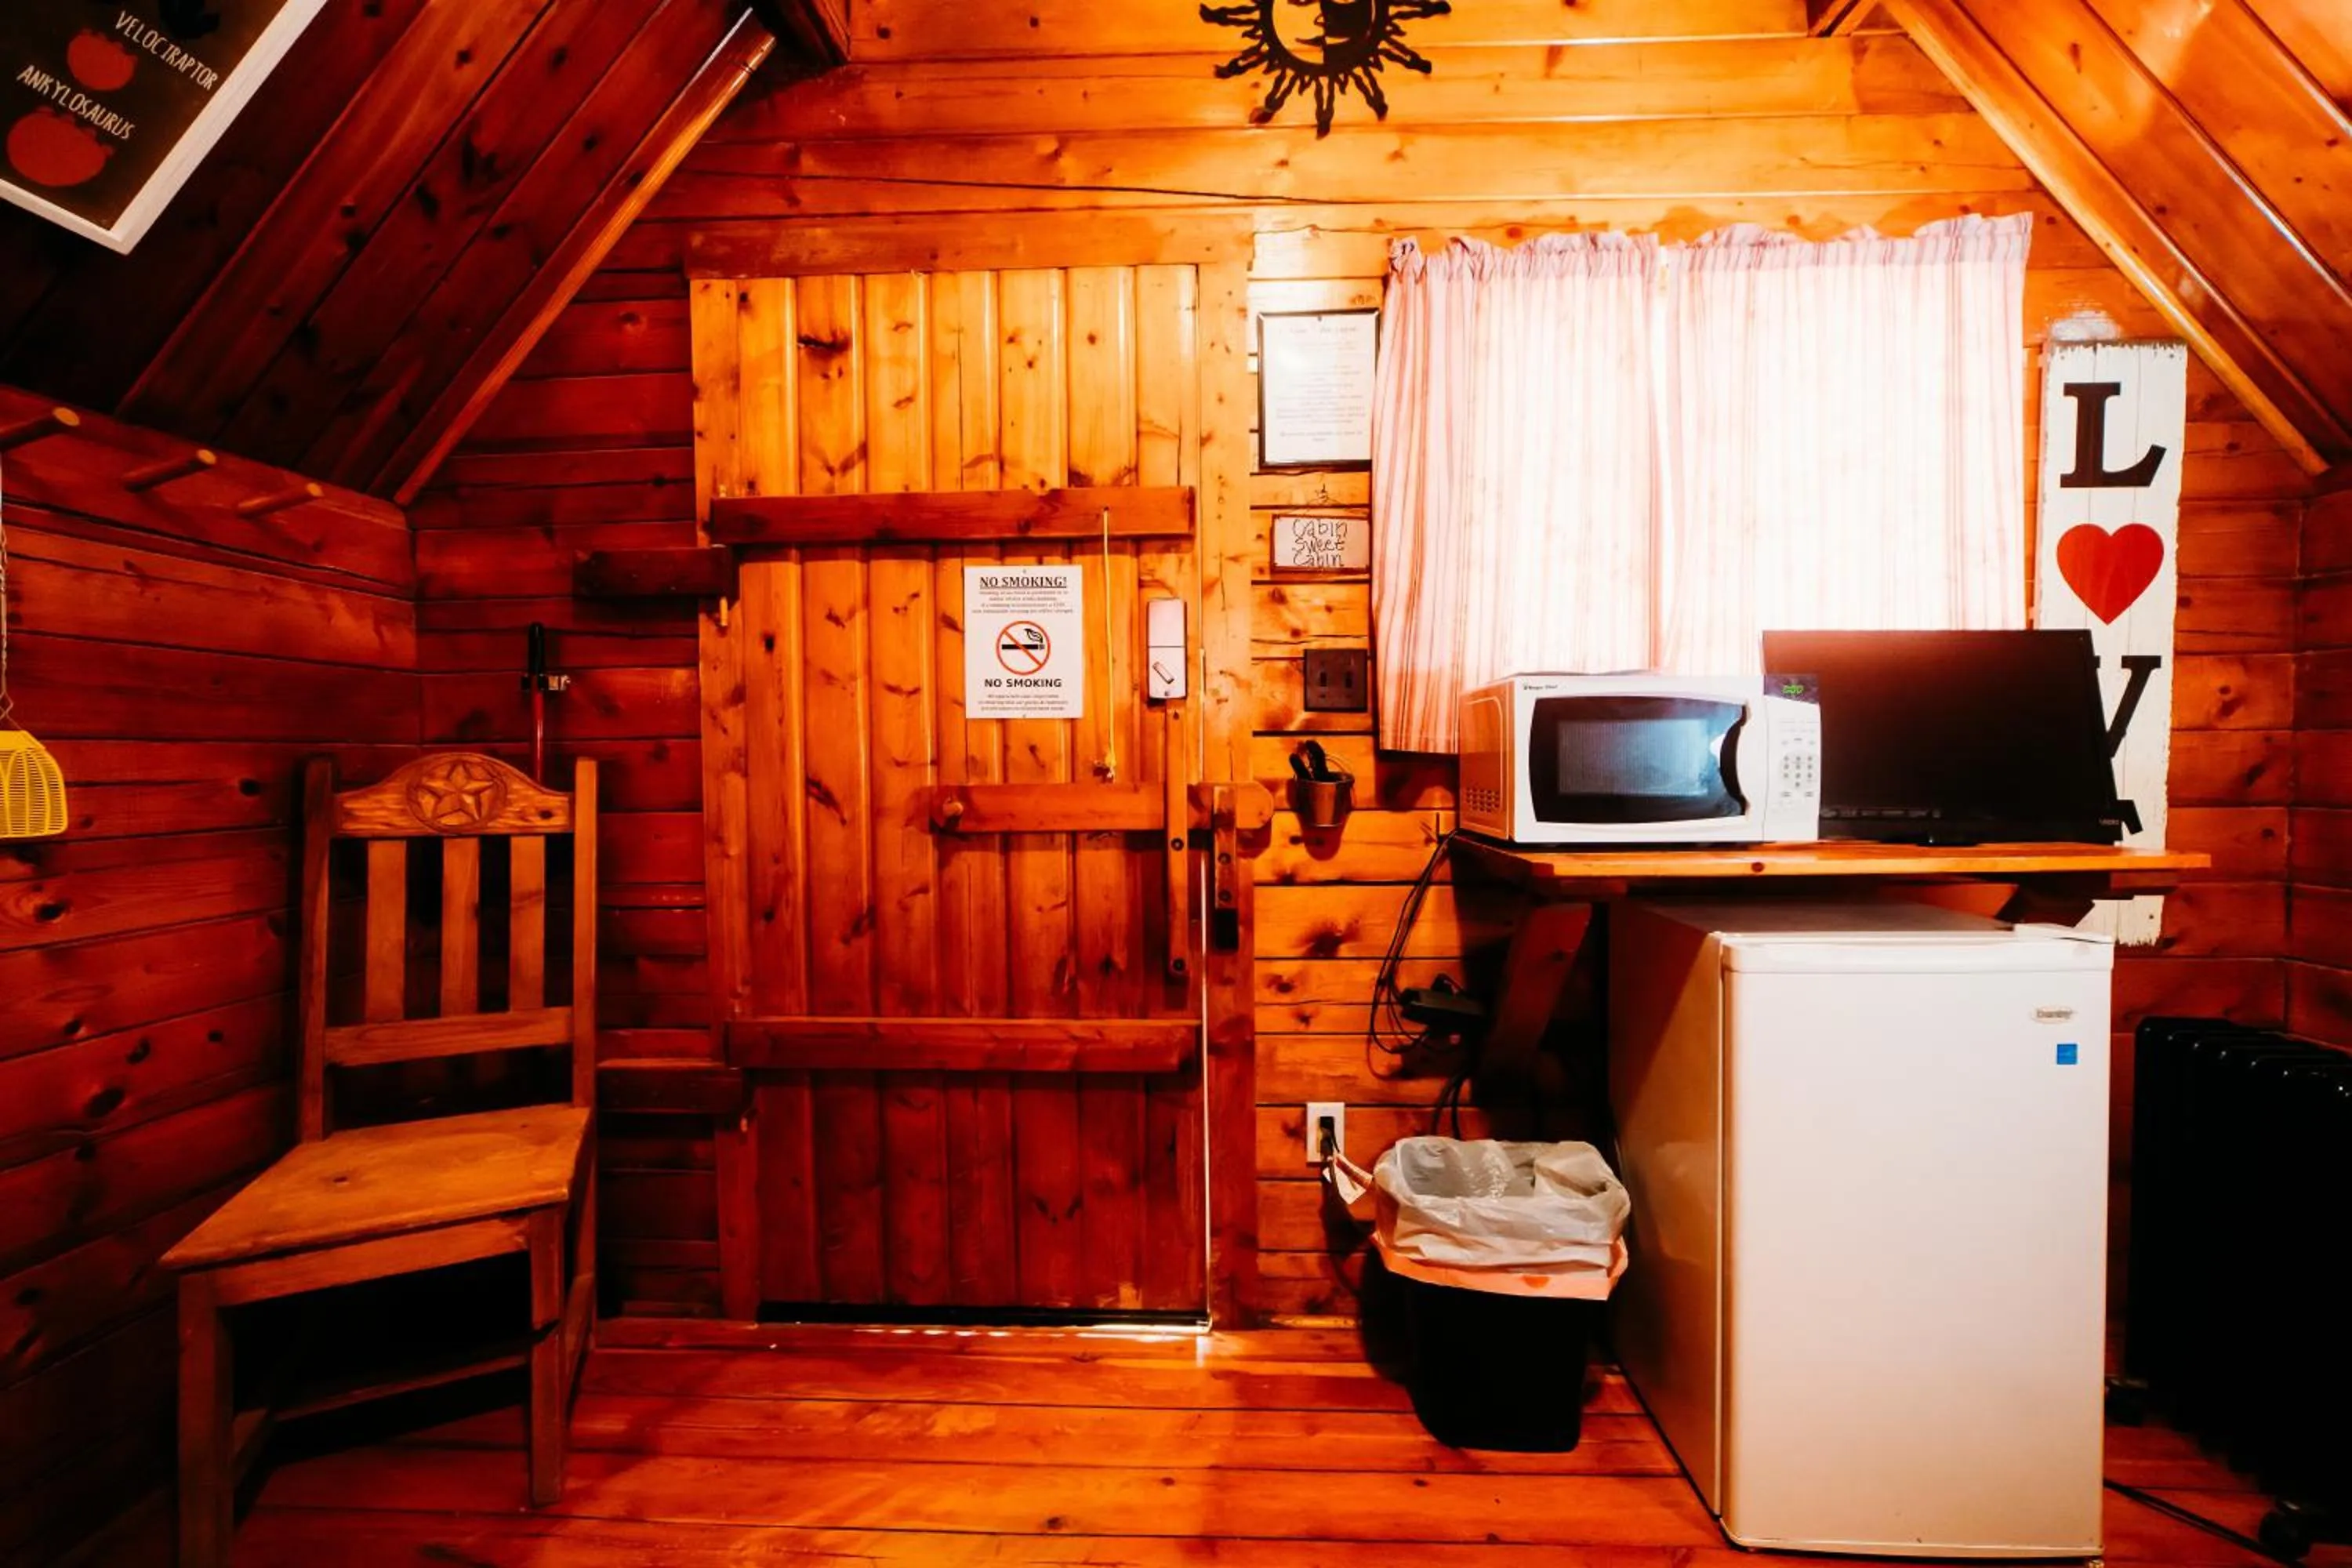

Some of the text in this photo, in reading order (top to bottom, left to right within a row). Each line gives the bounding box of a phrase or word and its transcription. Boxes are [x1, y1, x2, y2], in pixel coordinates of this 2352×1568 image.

[115, 10, 219, 91] VELOCIRAPTOR
[16, 64, 136, 140] ANKYLOSAURUS
[980, 576, 1067, 587] NO SMOKING!
[984, 678, 1062, 688] NO SMOKING
